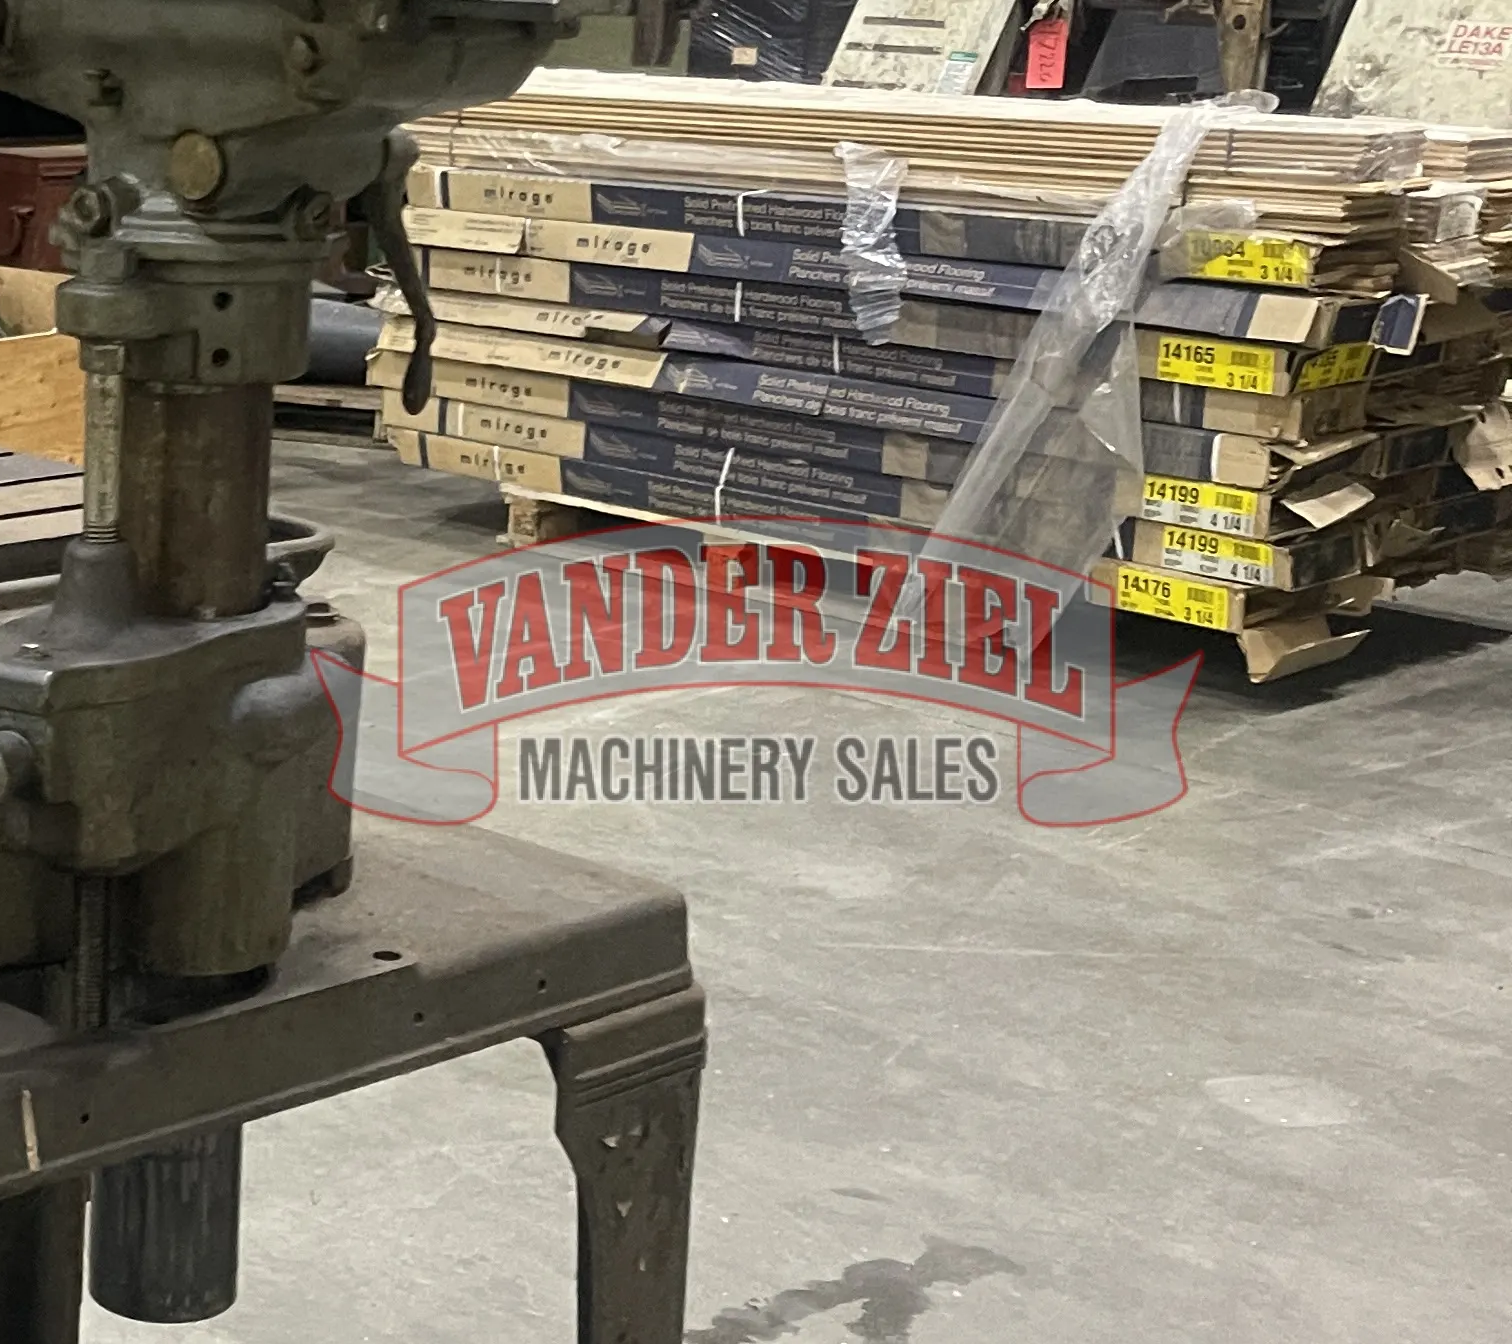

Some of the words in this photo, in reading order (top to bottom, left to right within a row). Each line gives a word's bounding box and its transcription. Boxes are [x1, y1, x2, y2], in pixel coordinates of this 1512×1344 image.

[1453, 24, 1512, 40] DAKE
[484, 186, 555, 206] mirage
[576, 235, 652, 256] mirage
[463, 265, 533, 285] mirage
[548, 349, 623, 370] mirage
[1162, 342, 1216, 365] 14165
[465, 376, 533, 398] mirage
[1226, 371, 1235, 388] 3
[480, 416, 549, 440] mirage
[460, 452, 526, 475] mirge
[1148, 481, 1200, 504] 14199
[1210, 513, 1218, 527] 4
[1167, 530, 1219, 554] 14199
[1230, 563, 1239, 578] 4
[1122, 574, 1171, 599] 14176
[1183, 606, 1192, 622] 3
